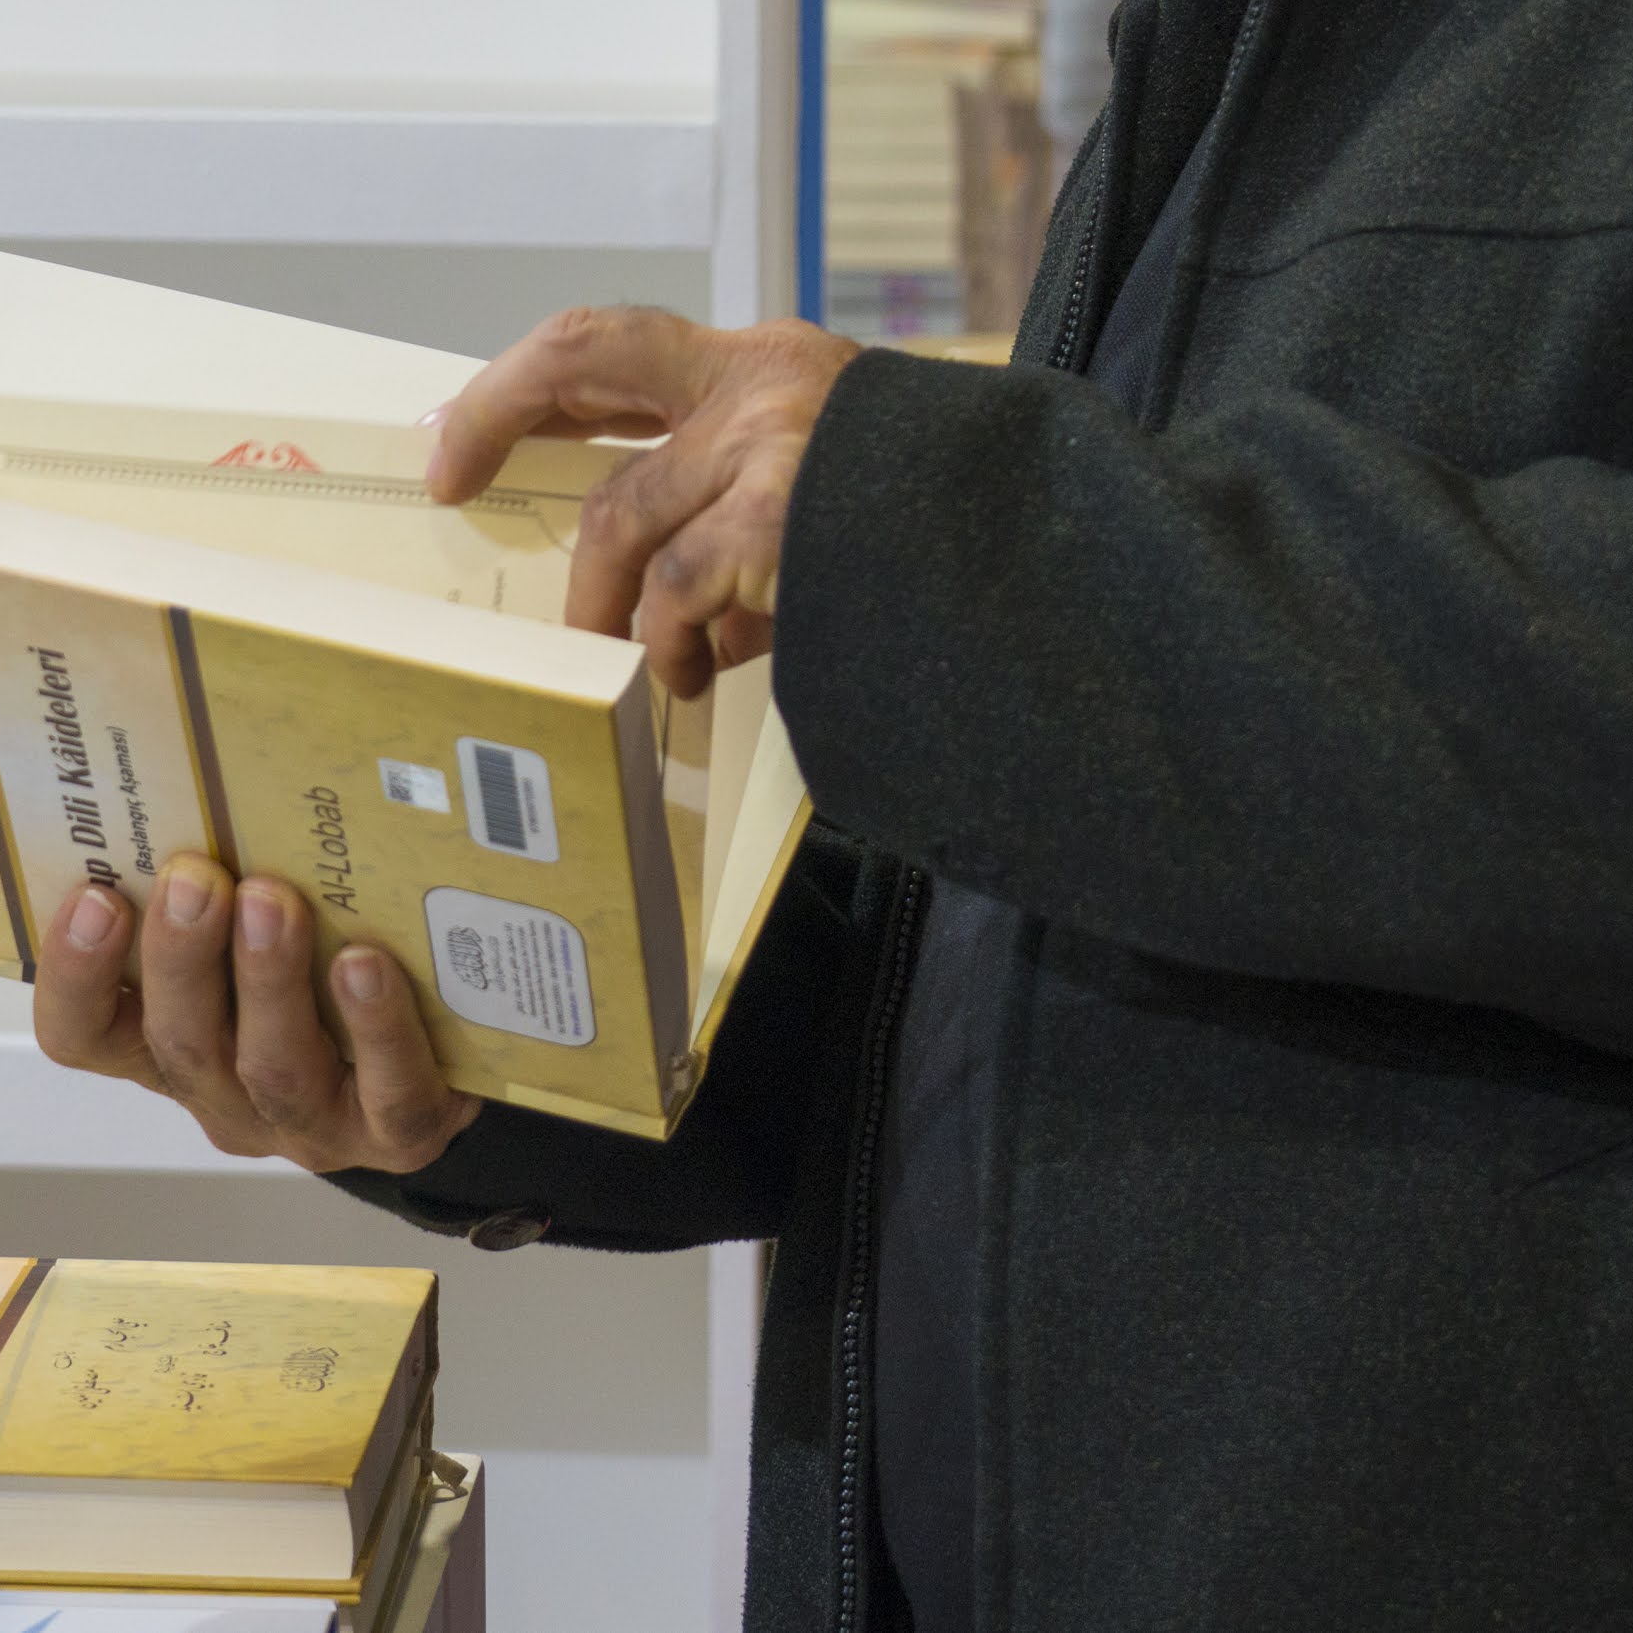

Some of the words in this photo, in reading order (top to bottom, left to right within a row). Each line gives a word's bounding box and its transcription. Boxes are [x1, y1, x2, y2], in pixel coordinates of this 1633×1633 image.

[27, 645, 95, 789] Kâideleri
[62, 795, 108, 850] Dili
[304, 785, 359, 915] Al-Lobab
